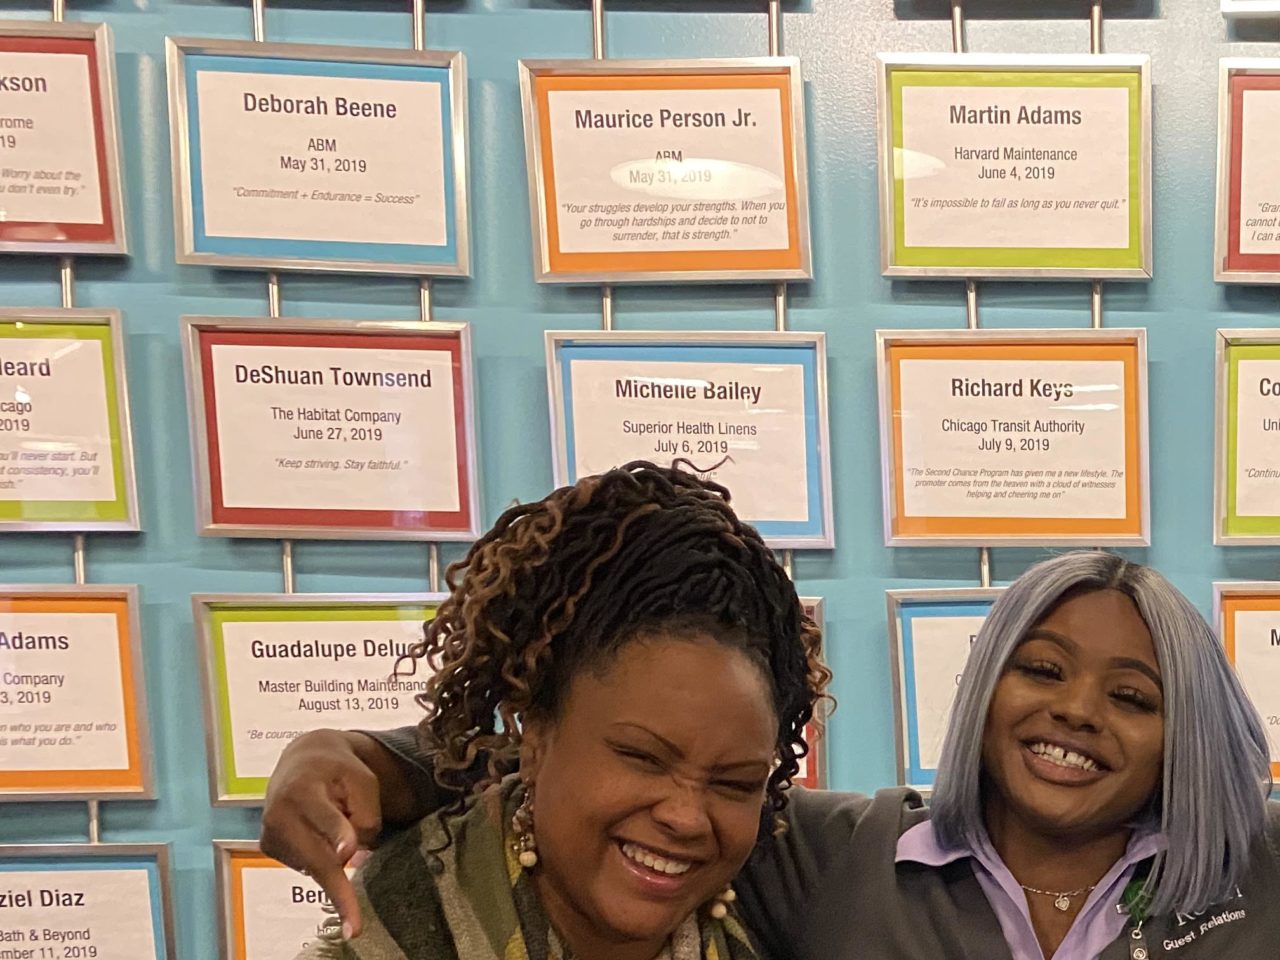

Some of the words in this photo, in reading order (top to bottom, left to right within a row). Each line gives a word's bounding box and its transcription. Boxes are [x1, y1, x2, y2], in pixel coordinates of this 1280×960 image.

[244, 93, 328, 115] Deborah
[335, 97, 397, 118] Beene
[575, 109, 653, 128] Maurice
[660, 109, 725, 128] Person
[732, 108, 756, 127] Jr.
[950, 105, 1010, 124] Martin
[1017, 106, 1082, 125] Adams
[307, 138, 336, 152] ABM
[954, 147, 1000, 160] Harvard
[1003, 147, 1077, 161] Maintenance
[235, 365, 323, 385] DeShuan
[329, 367, 431, 388] Townsend
[616, 379, 696, 399] Michelle
[703, 382, 761, 404] Bailey
[952, 378, 1023, 397] Richard
[1030, 379, 1073, 402] Keys
[271, 407, 294, 420] The
[297, 408, 341, 422] Habitat
[344, 408, 401, 425] Company
[623, 420, 673, 436] Superior
[677, 421, 714, 435] Health
[718, 422, 757, 436] Linens
[942, 419, 988, 435] Chicago
[991, 419, 1031, 432] Transit
[1033, 420, 1085, 435] Authority
[251, 640, 356, 661] Guadalupe
[3, 672, 65, 688] Company
[259, 680, 301, 693] Master
[305, 680, 354, 695] Building
[298, 698, 341, 713] August
[344, 697, 364, 711] 13,
[367, 697, 399, 710] 2019
[40, 889, 85, 907] Diaz
[29, 929, 39, 941] &
[43, 928, 91, 943] Beyond
[1163, 931, 1196, 950] Guest
[1200, 910, 1246, 935] Relations
[39, 947, 60, 960] 11,
[63, 945, 97, 958] 2019
